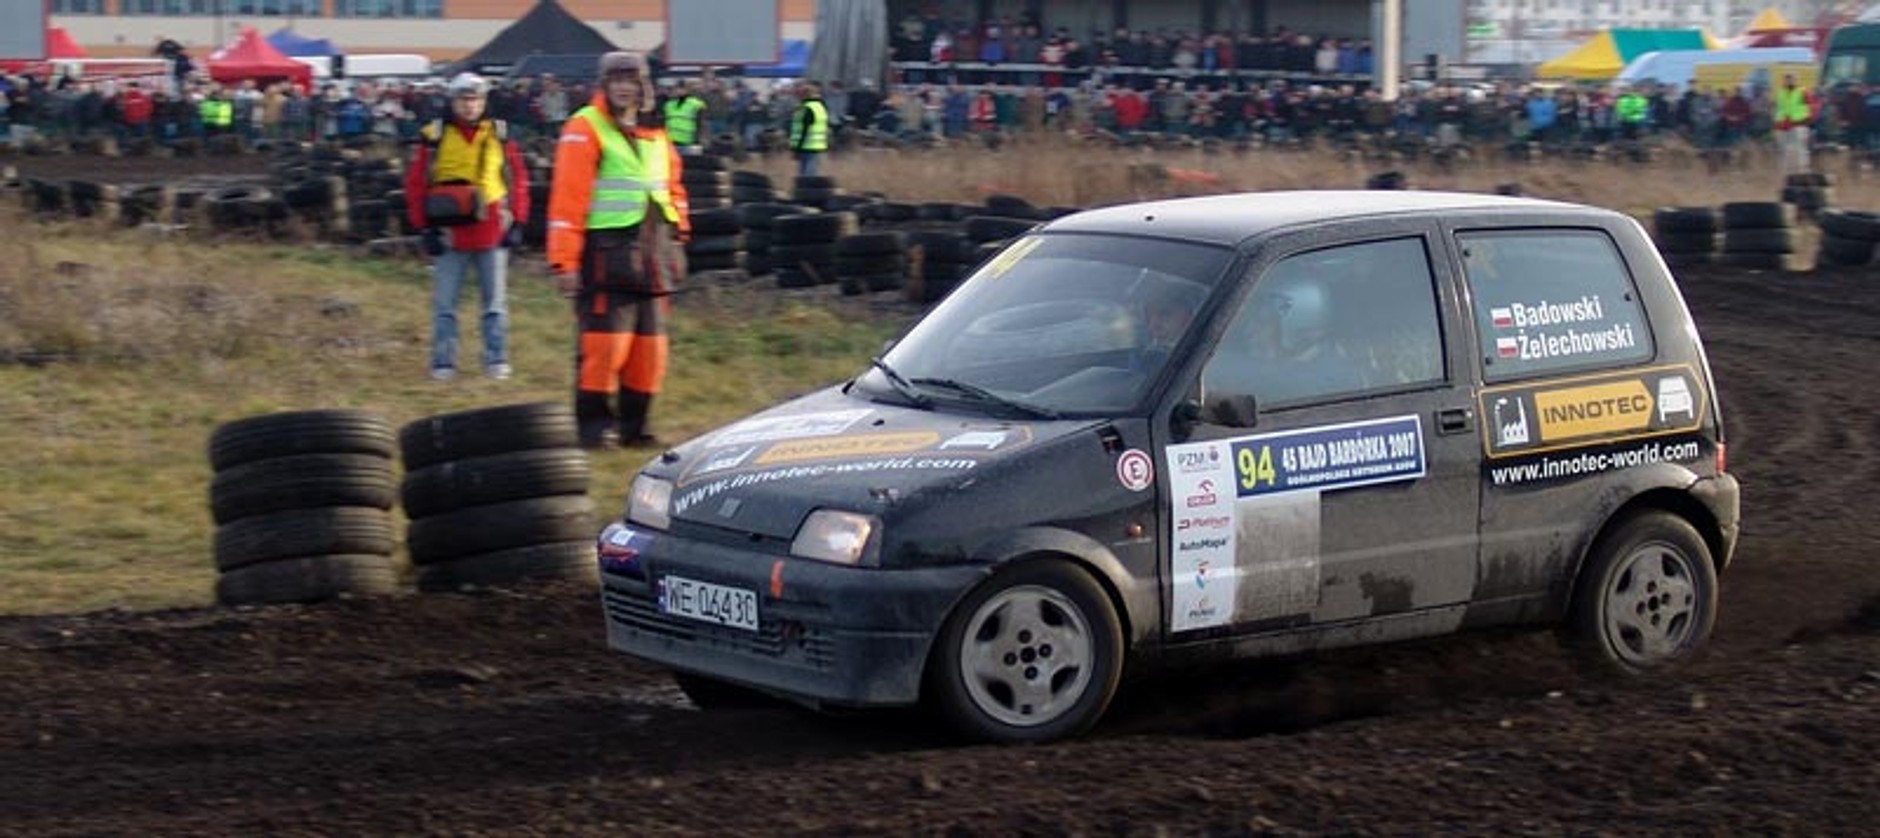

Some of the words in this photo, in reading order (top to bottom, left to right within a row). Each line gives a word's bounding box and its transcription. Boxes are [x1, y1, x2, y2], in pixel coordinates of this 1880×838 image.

[1512, 295, 1603, 327] Badowski
[1518, 323, 1635, 360] Żelechowski
[1543, 395, 1648, 423] INNOTEC
[1130, 460, 1143, 480] E
[1238, 446, 1275, 489] 94
[1282, 447, 1298, 473] 45
[1298, 443, 1327, 471] RAJD
[1328, 430, 1388, 467] BARBÓRKA
[1389, 431, 1416, 459] 2007
[1492, 441, 1699, 484] www.innotec-world.com
[674, 454, 977, 514] www.innotec-world.com
[668, 579, 693, 614] WE
